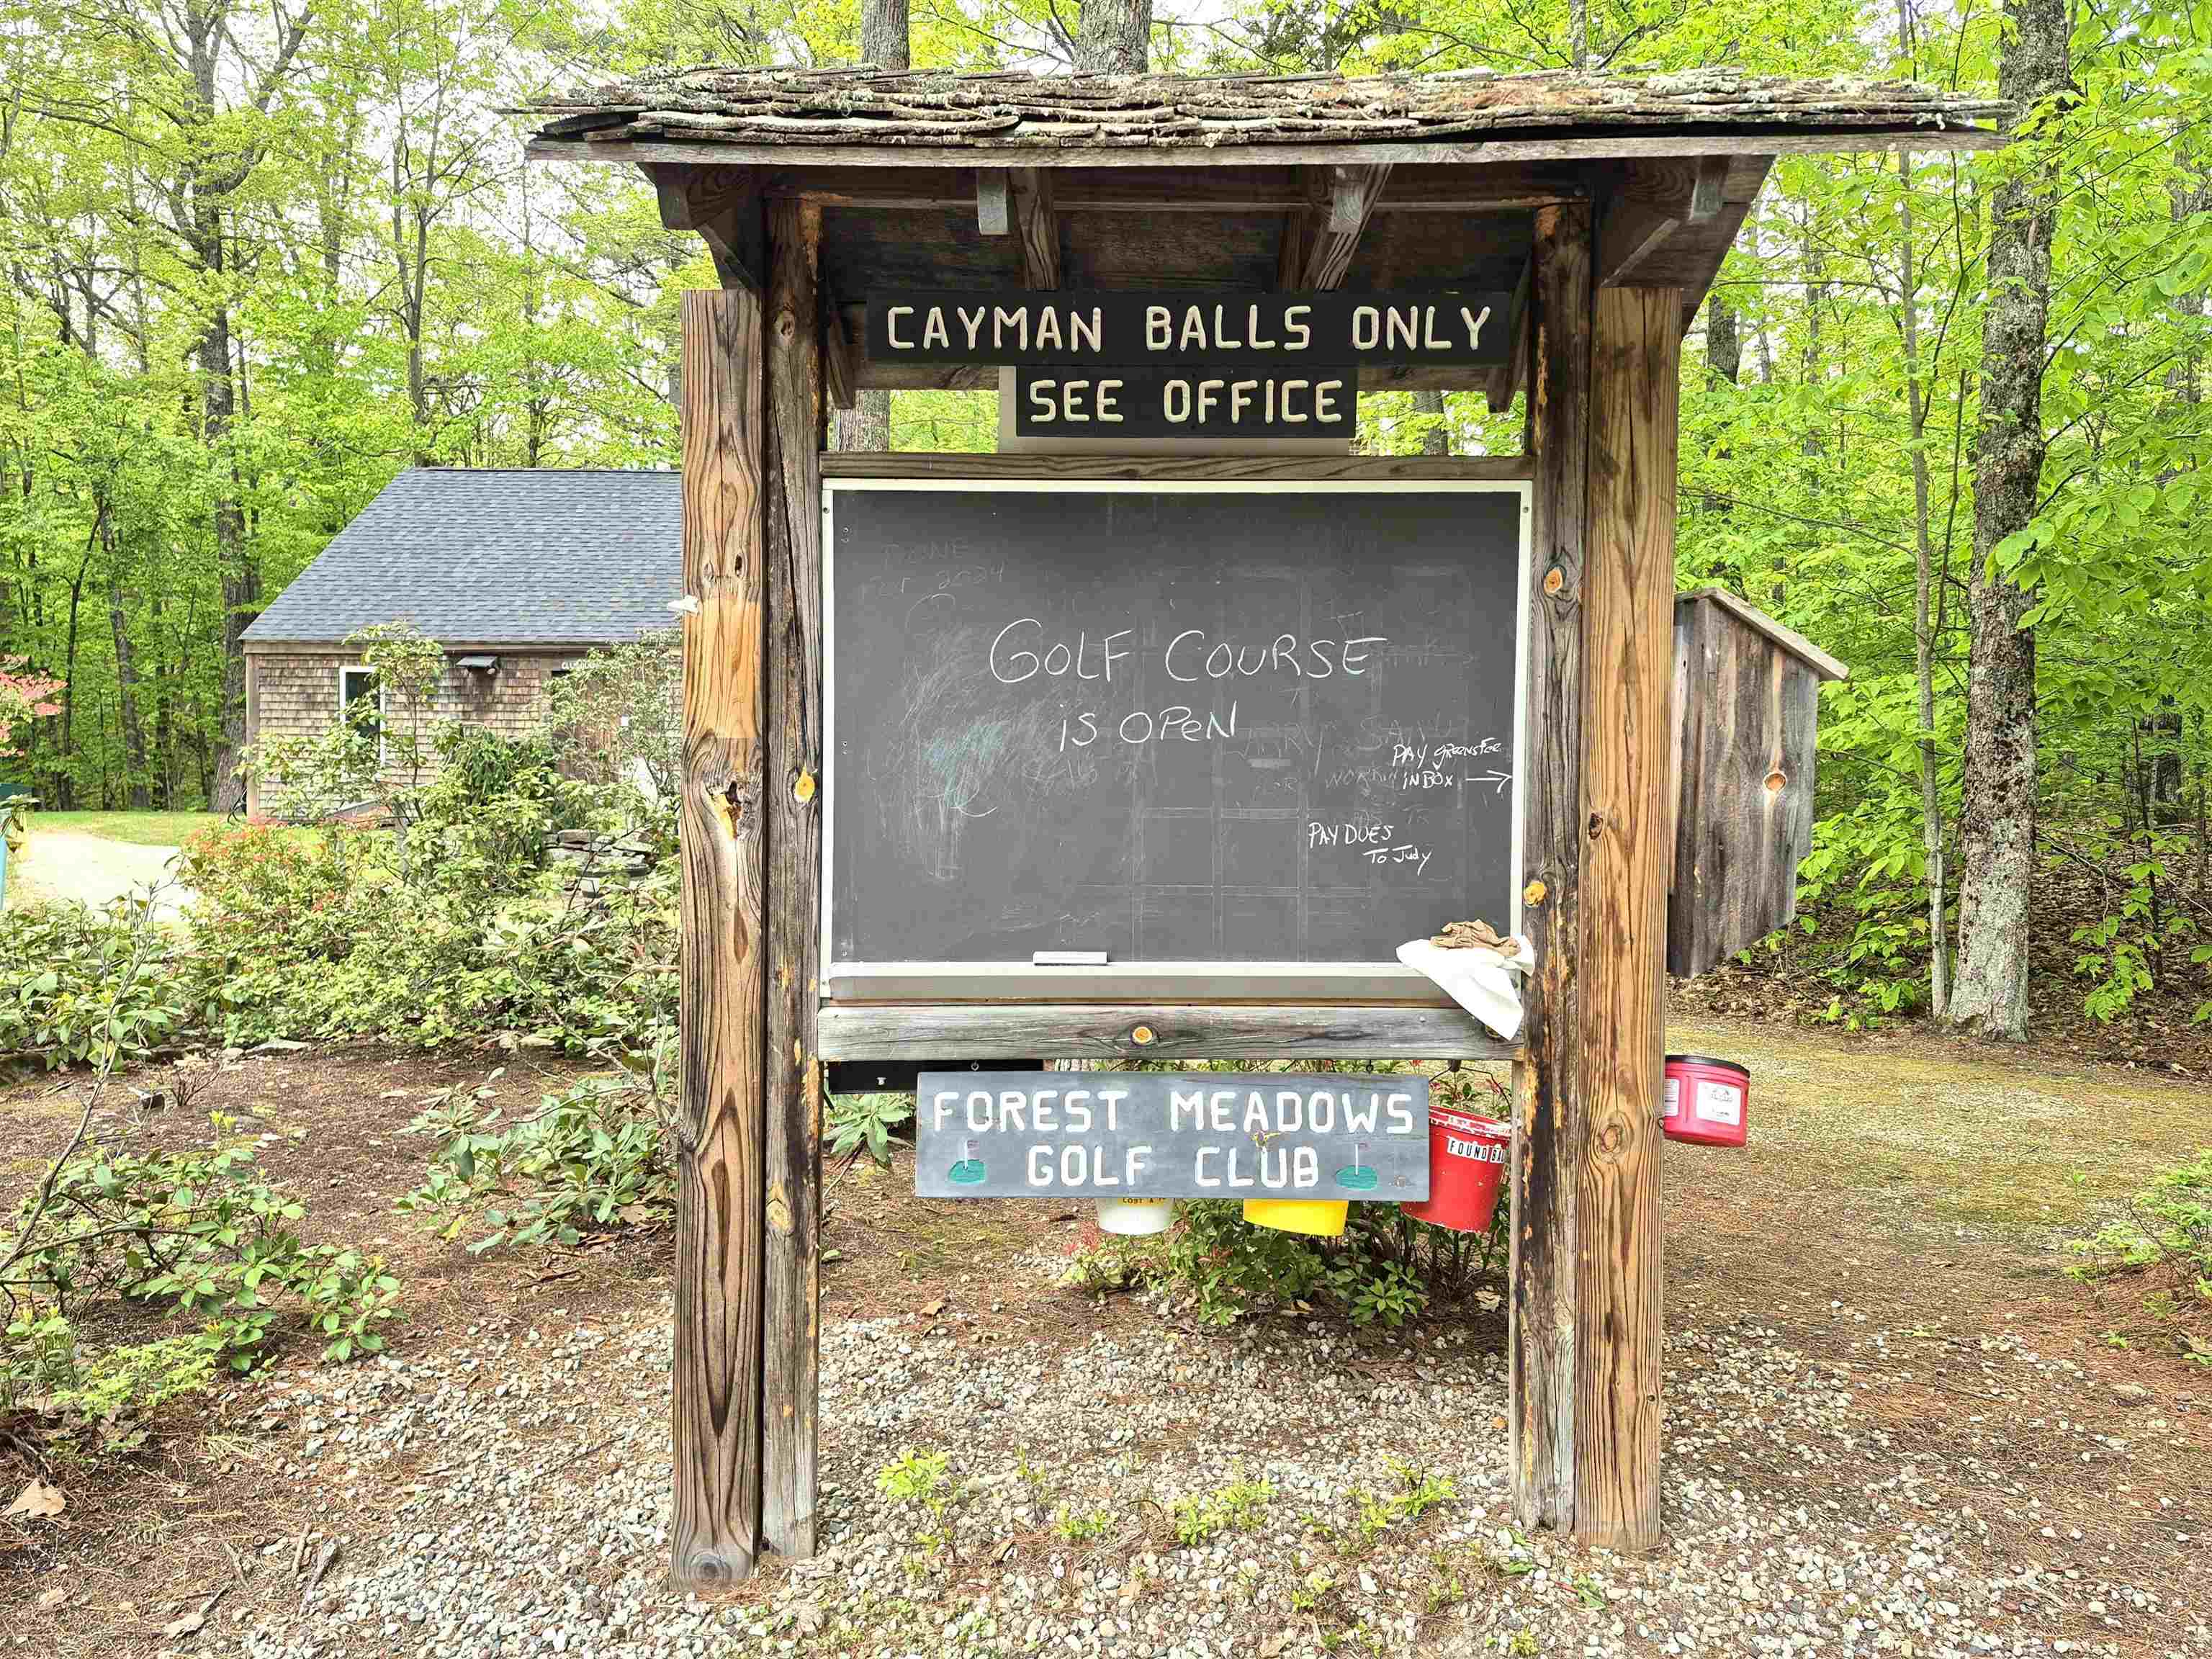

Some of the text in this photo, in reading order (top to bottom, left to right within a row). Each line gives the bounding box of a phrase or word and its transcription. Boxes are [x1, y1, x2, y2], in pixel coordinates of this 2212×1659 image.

[887, 304, 1491, 353] CAYMAN BALLS ONLY
[1030, 379, 1343, 423] SEE OFFICE
[1165, 629, 1388, 682] COURSE
[1392, 742, 1428, 769] PAY
[1308, 822, 1395, 849] PAY DUES
[1362, 844, 1432, 876] To Judy
[933, 1089, 1413, 1135] FOREST MEADOWS
[1027, 1143, 1319, 1188] GOLF CLUB
[1449, 1140, 1488, 1159] FOUND
